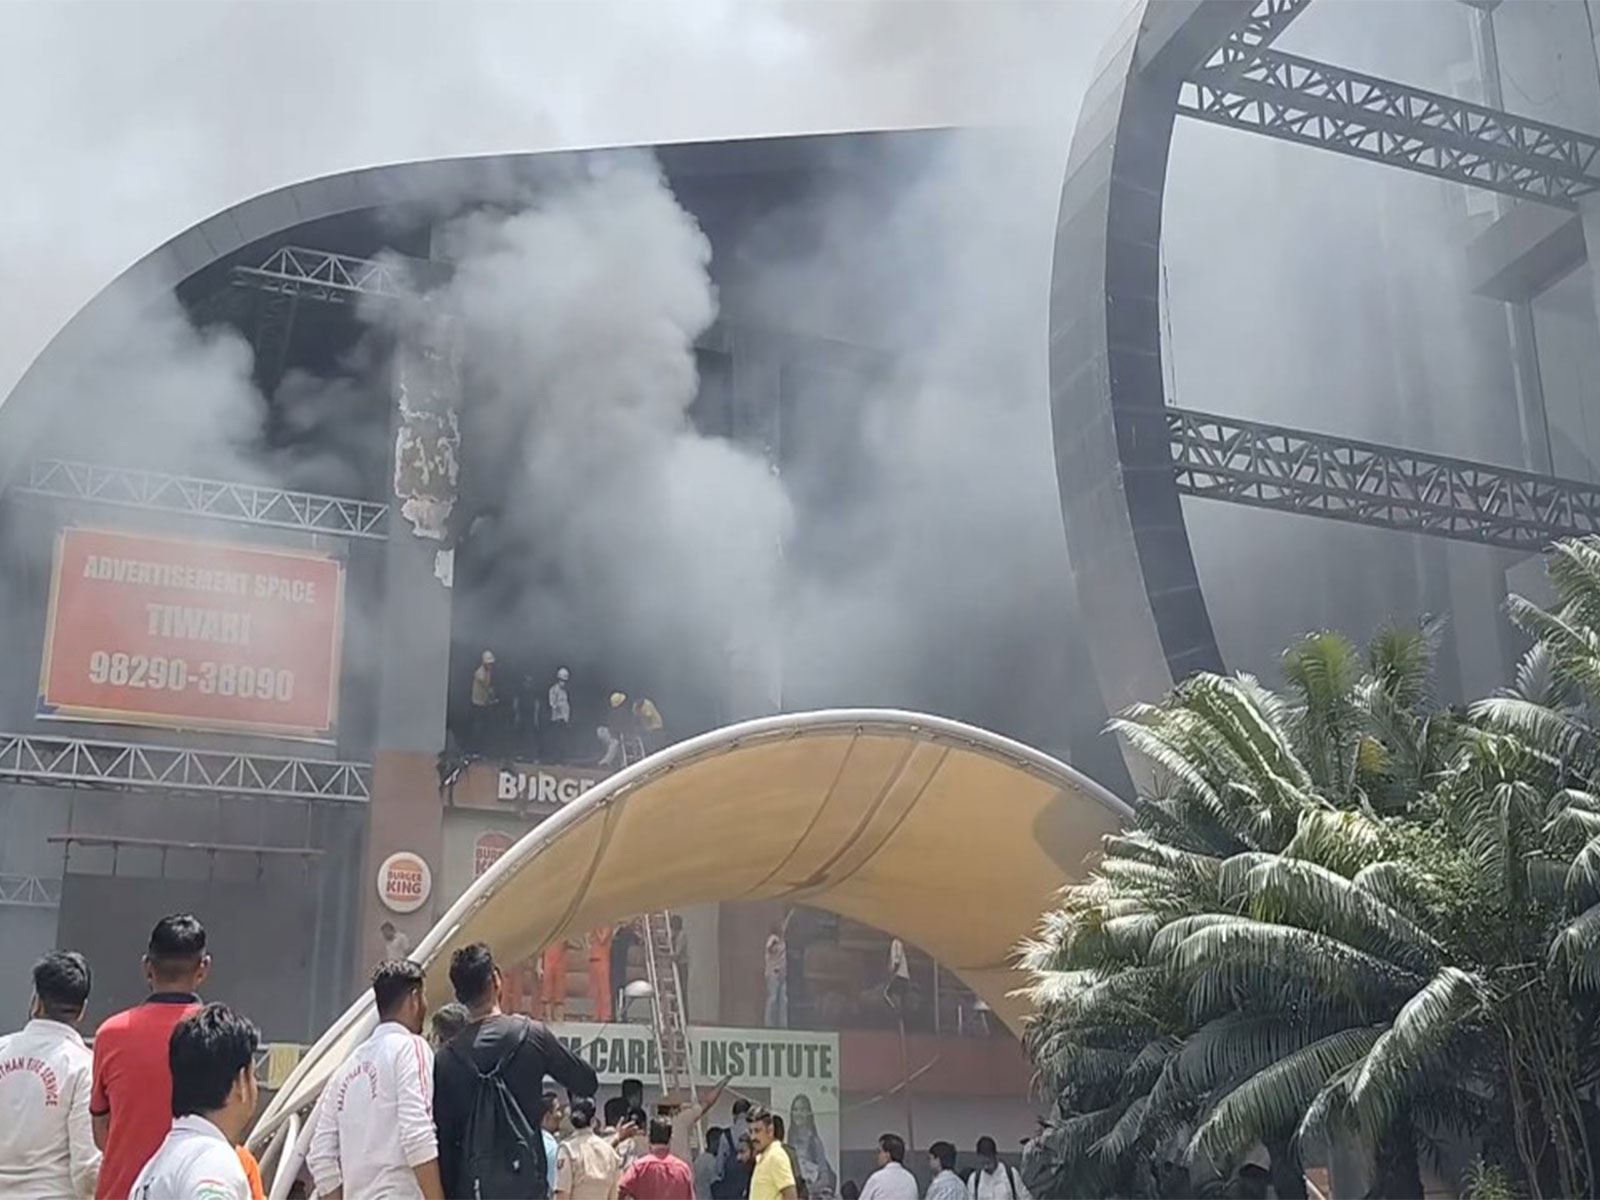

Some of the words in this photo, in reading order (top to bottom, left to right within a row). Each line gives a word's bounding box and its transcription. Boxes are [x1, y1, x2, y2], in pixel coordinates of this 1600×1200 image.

[83, 555, 250, 597] ADVERTISEMENT
[254, 574, 317, 604] SPACE
[146, 603, 251, 646] TIWARI
[88, 651, 295, 702] 98290-38090
[386, 880, 422, 894] KING
[387, 870, 422, 882] BURGER
[700, 1040, 833, 1079] INSTITUTE
